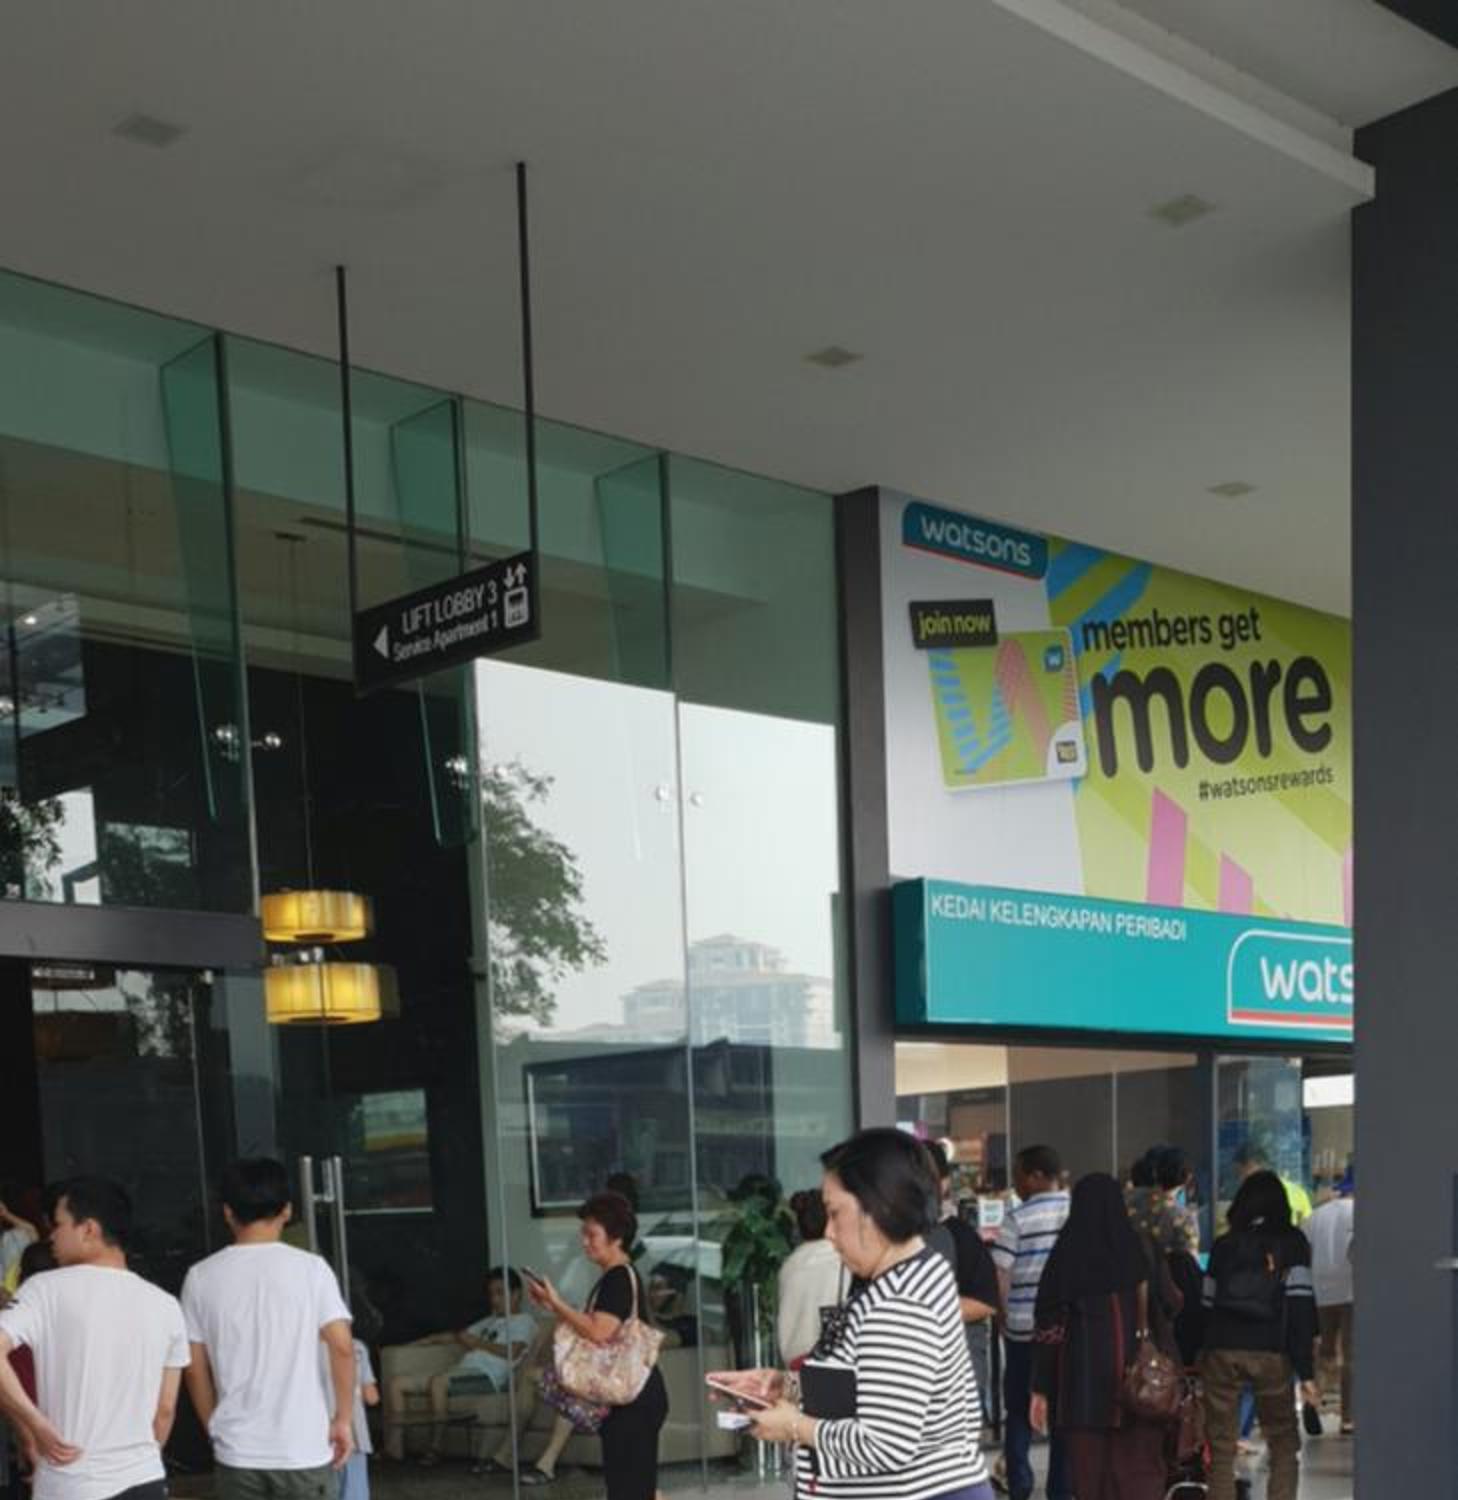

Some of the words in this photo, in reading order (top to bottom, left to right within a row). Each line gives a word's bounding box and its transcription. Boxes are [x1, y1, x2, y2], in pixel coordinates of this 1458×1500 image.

[919, 514, 1032, 566] watsons
[402, 603, 432, 634] LIFT
[435, 585, 483, 622] LOBBY
[488, 579, 498, 605] 3
[919, 611, 951, 641] join
[953, 615, 992, 635] now
[1083, 608, 1212, 651] members
[1221, 607, 1262, 650] get
[393, 635, 432, 662] Service
[434, 613, 489, 648] Apartment
[491, 609, 498, 627] 1
[1090, 656, 1334, 778] more
[1199, 765, 1335, 800] #watsonsrewards
[930, 894, 986, 921] KEDAI
[991, 898, 1112, 934] KELENGKAPAN
[1115, 913, 1187, 941] PERIBADI
